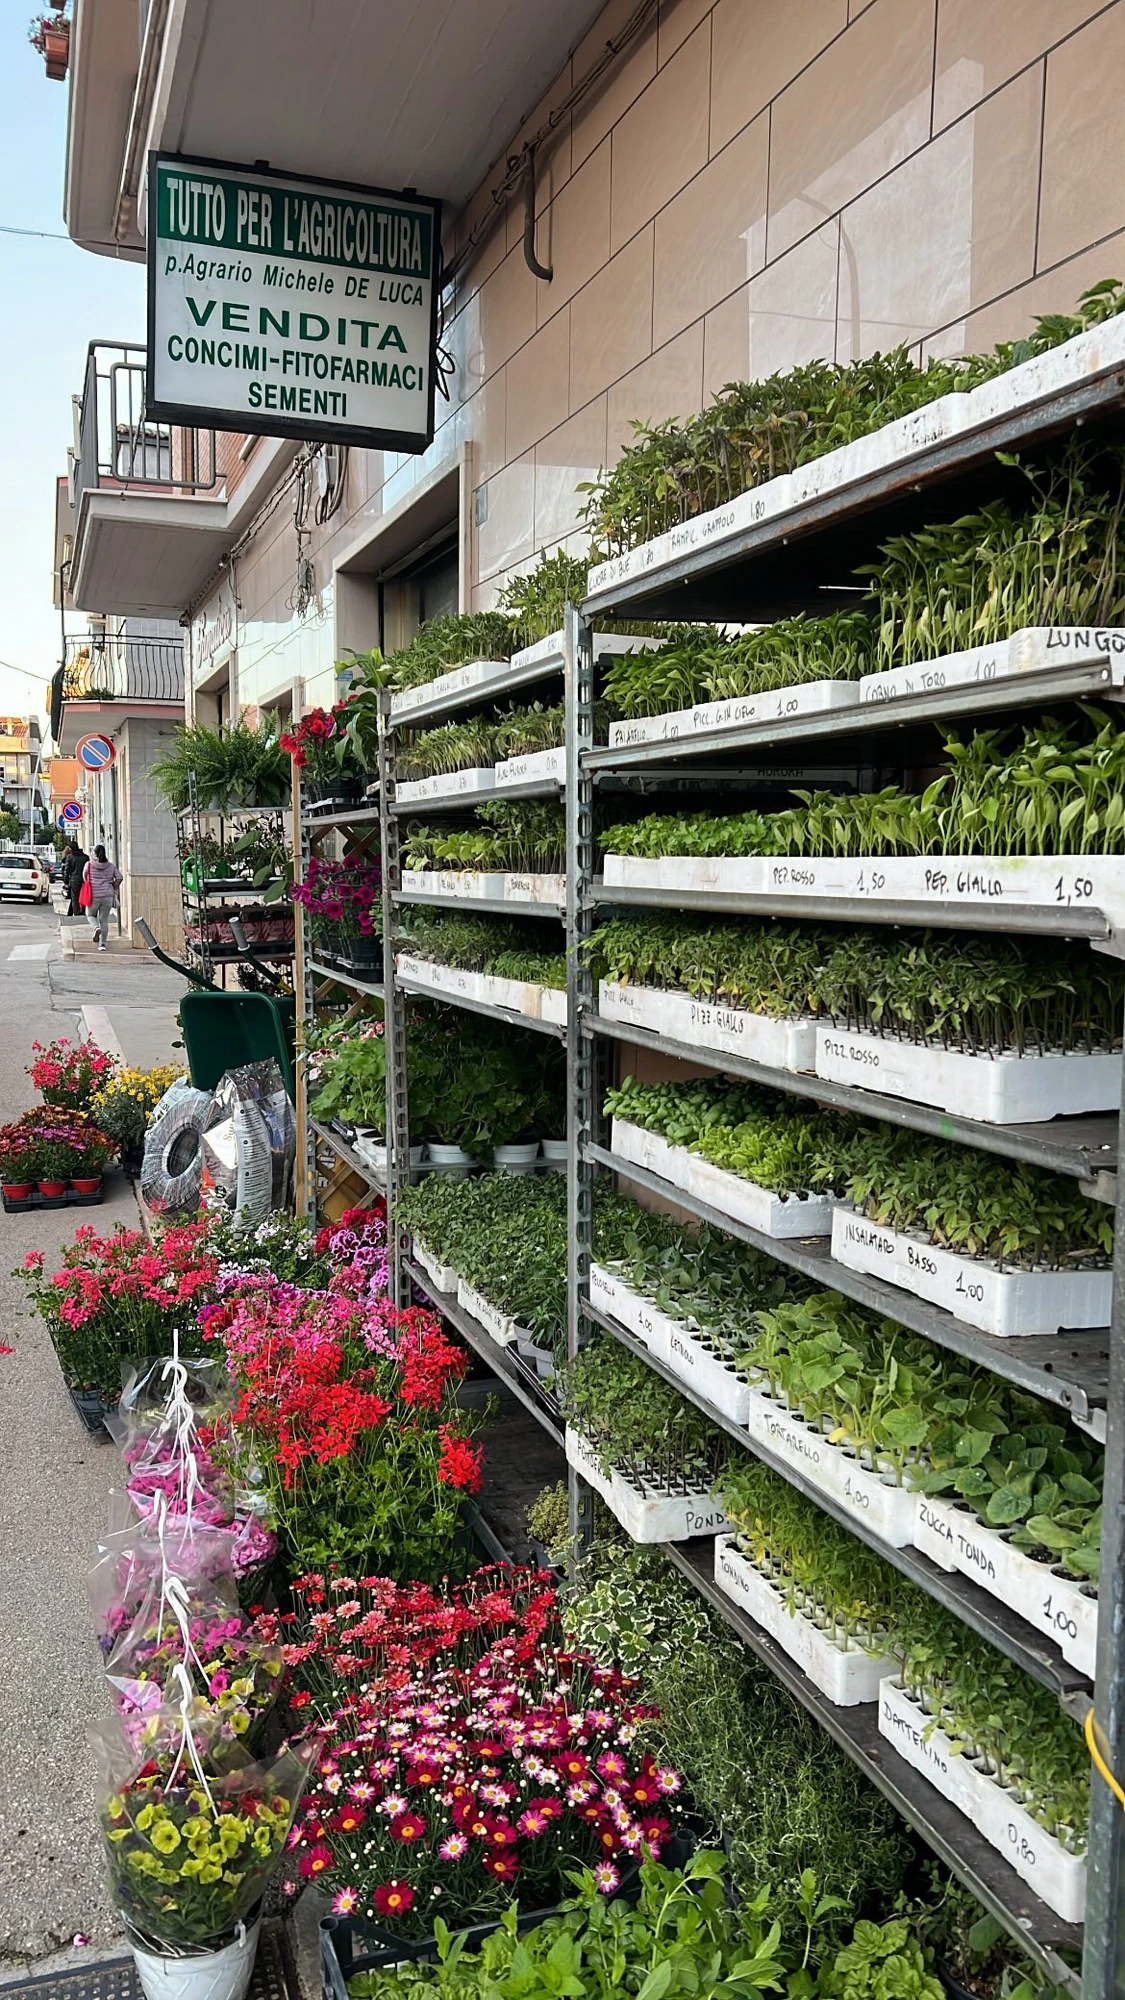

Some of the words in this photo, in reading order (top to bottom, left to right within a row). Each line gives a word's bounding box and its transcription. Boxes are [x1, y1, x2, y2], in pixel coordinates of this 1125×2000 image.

[166, 177, 226, 241] TUTTO
[237, 188, 273, 248] PER
[283, 197, 423, 271] L'AGRICOLTURA
[263, 264, 334, 294] Michele
[345, 276, 370, 299] DE
[379, 280, 423, 306] LUCA
[185, 296, 408, 353] VENDITA
[168, 335, 423, 391] CONCIMI-FITOFARMACI
[248, 381, 347, 417] SEMENTI
[702, 513, 735, 536] GRAPPOLO
[1046, 628, 1125, 653] LUNGO
[921, 672, 946, 690] TORO
[735, 705, 755, 720] CIELO
[857, 869, 885, 895] 1,50
[925, 869, 949, 895] PEP.
[957, 871, 1003, 896] GIALLO
[1055, 876, 1093, 907] 1,50
[907, 1246, 937, 1275] BASSO
[955, 1270, 984, 1301] 1,00
[764, 1414, 820, 1463] TORTARELLO
[845, 1477, 869, 1508] 1,00
[685, 1511, 730, 1533] POND.
[919, 1503, 954, 1544] ZUCCA
[957, 1534, 996, 1579] TONDA
[1043, 1594, 1078, 1639] 1,00
[884, 1701, 948, 1773] DATTERINO
[1008, 1823, 1036, 1865] 0,80
